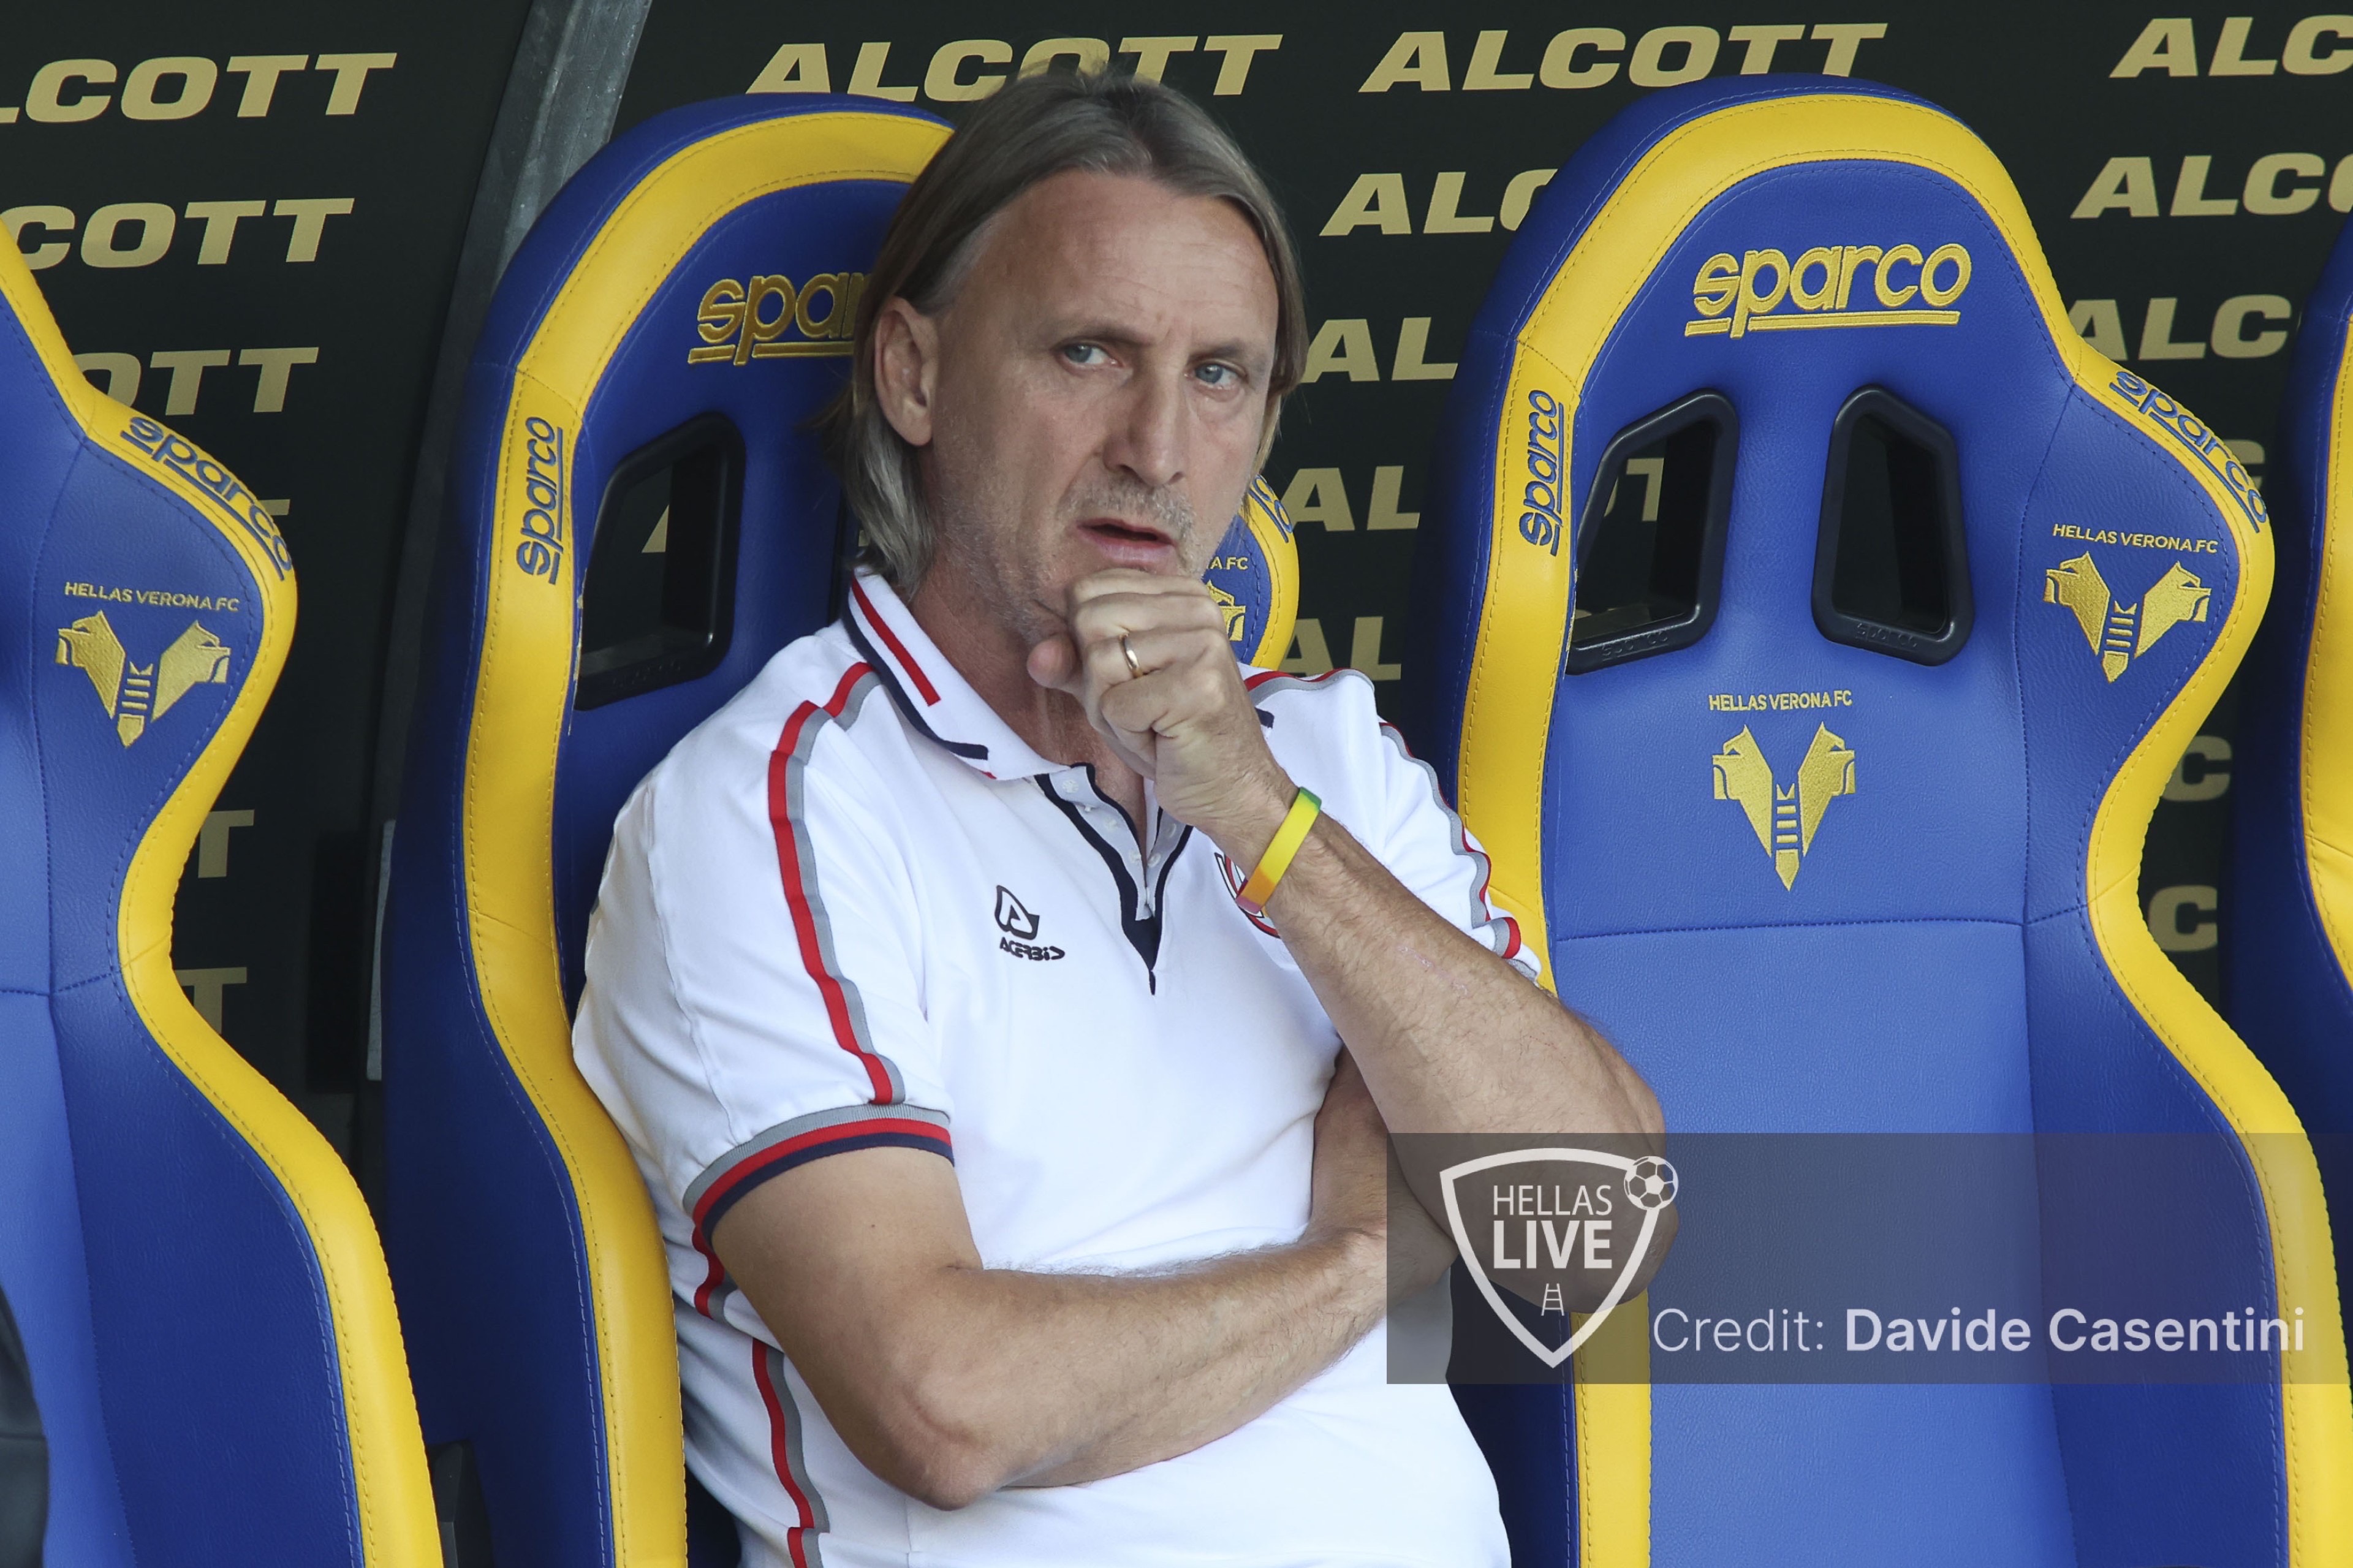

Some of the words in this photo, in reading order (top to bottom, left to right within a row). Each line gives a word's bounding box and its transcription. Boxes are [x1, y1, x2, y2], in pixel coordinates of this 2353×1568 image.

[0, 53, 397, 123] COTT
[745, 34, 1283, 102] ALCOTT
[1358, 23, 1889, 93] ALCOTT
[1684, 243, 1972, 339] sparco
[1519, 389, 1564, 556] sparco
[2109, 370, 2268, 534] sparco
[120, 415, 294, 581] sparco
[515, 417, 563, 585] sparco
[1226, 556, 1249, 570] FC
[2053, 523, 2117, 544] HELLAS
[2120, 531, 2194, 552] VERONA
[2195, 539, 2219, 554] FC
[64, 581, 132, 603] HELLAS
[135, 589, 212, 610] VERONA
[215, 597, 240, 612] FC
[1708, 694, 1767, 711] HELLAS
[1768, 692, 1832, 711] VERONA
[1833, 689, 1854, 707] FC
